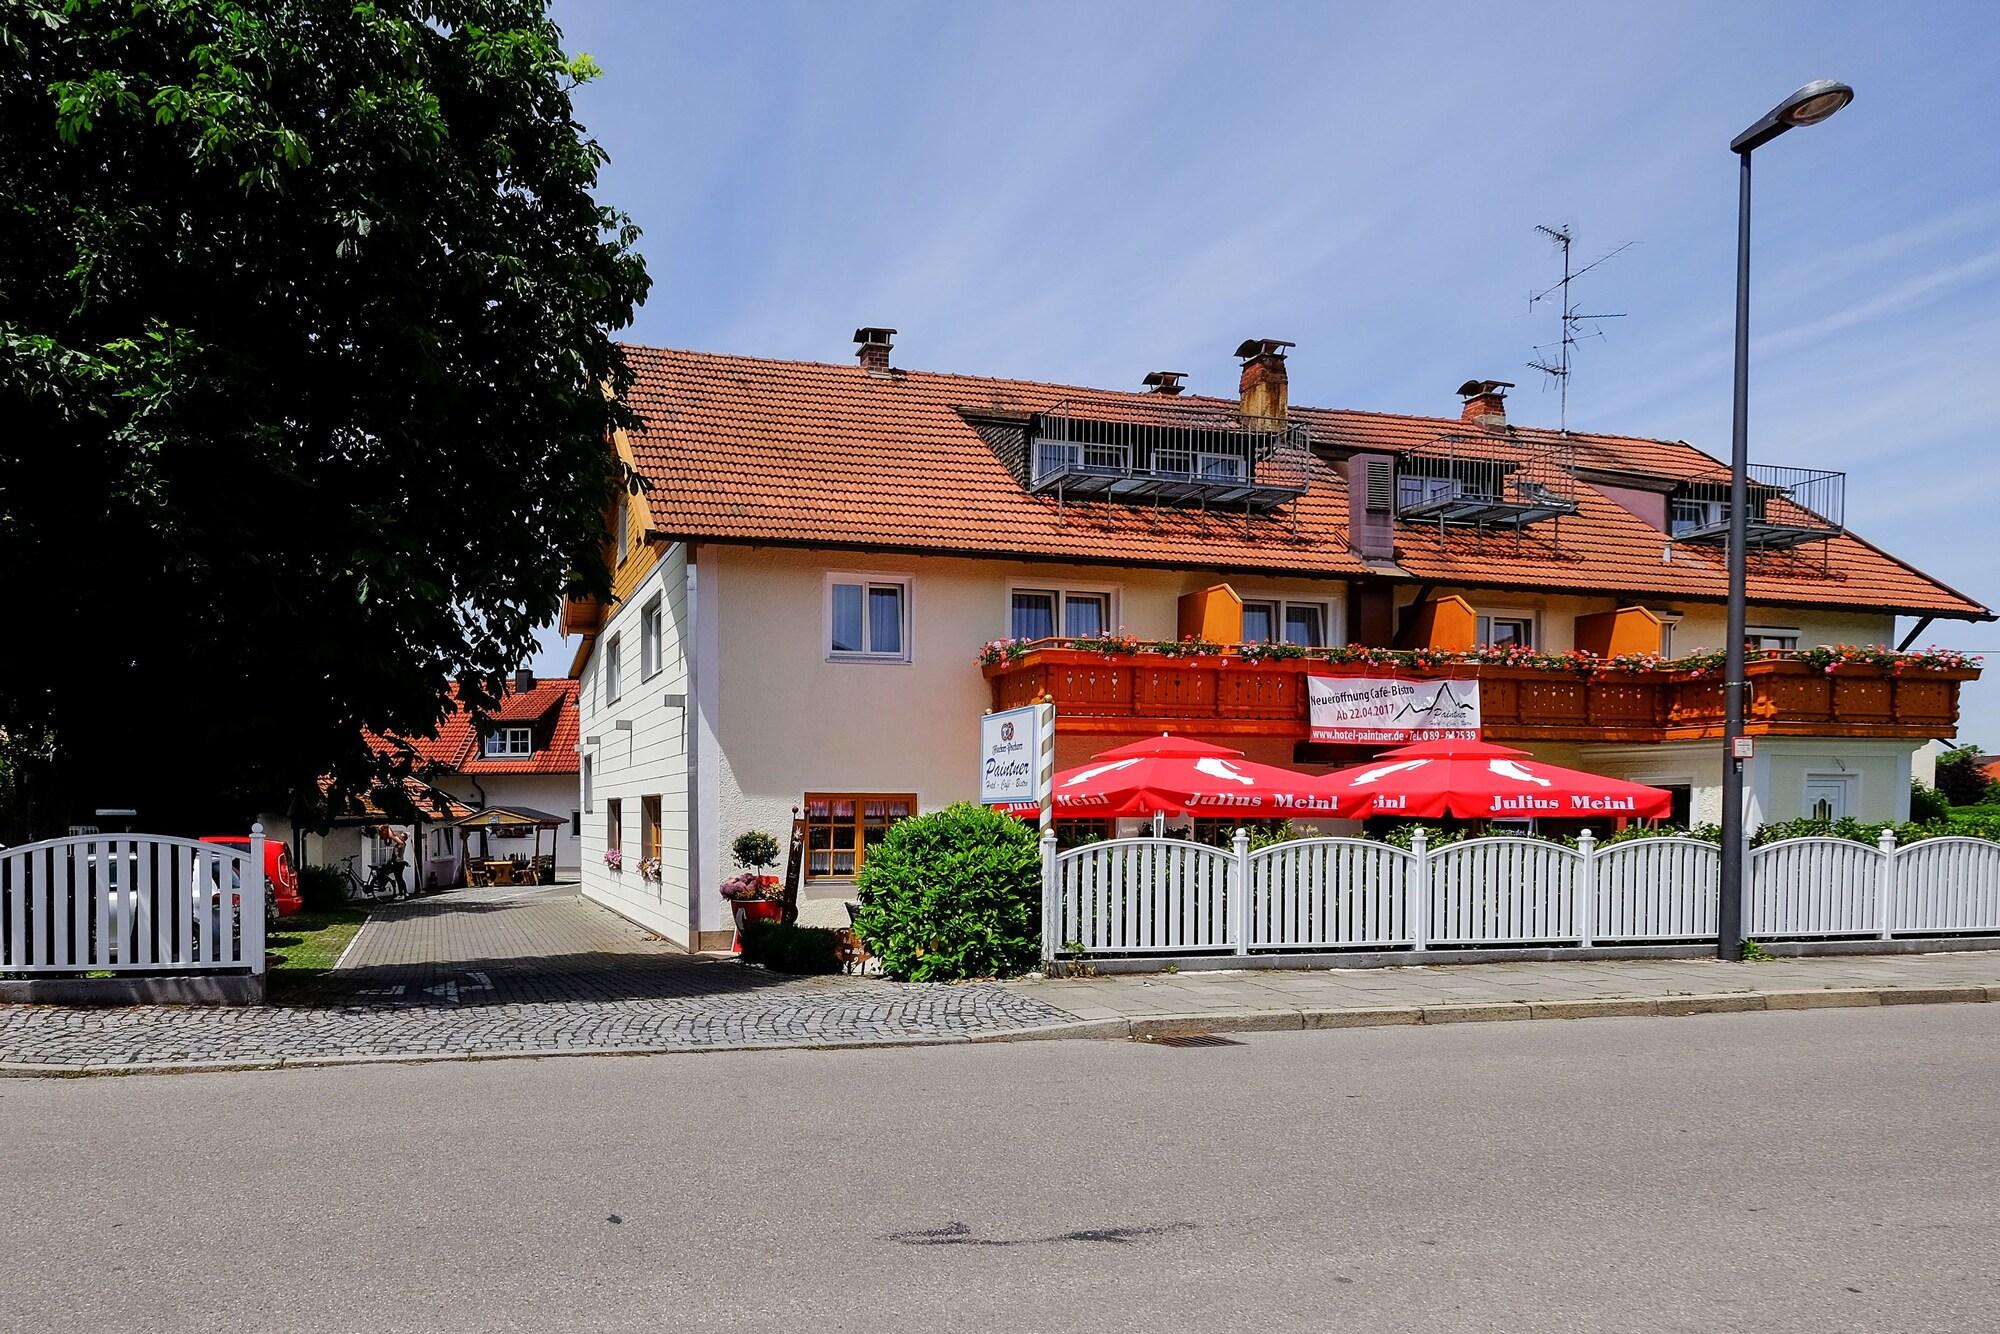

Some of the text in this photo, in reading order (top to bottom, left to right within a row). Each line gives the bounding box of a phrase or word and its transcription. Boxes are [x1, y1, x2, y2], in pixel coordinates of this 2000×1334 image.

[1311, 685, 1414, 706] Neueröffnung Café-Bistro
[1336, 704, 1394, 721] Ab 22.04.2017
[1312, 729, 1404, 741] www.hotel-paintner.de
[985, 757, 1029, 779] Paintner
[1056, 794, 1111, 808] Meinl
[1185, 792, 1339, 810] Julius Meinl
[1373, 795, 1406, 809] inl
[1489, 794, 1636, 811] Julius Meinl
